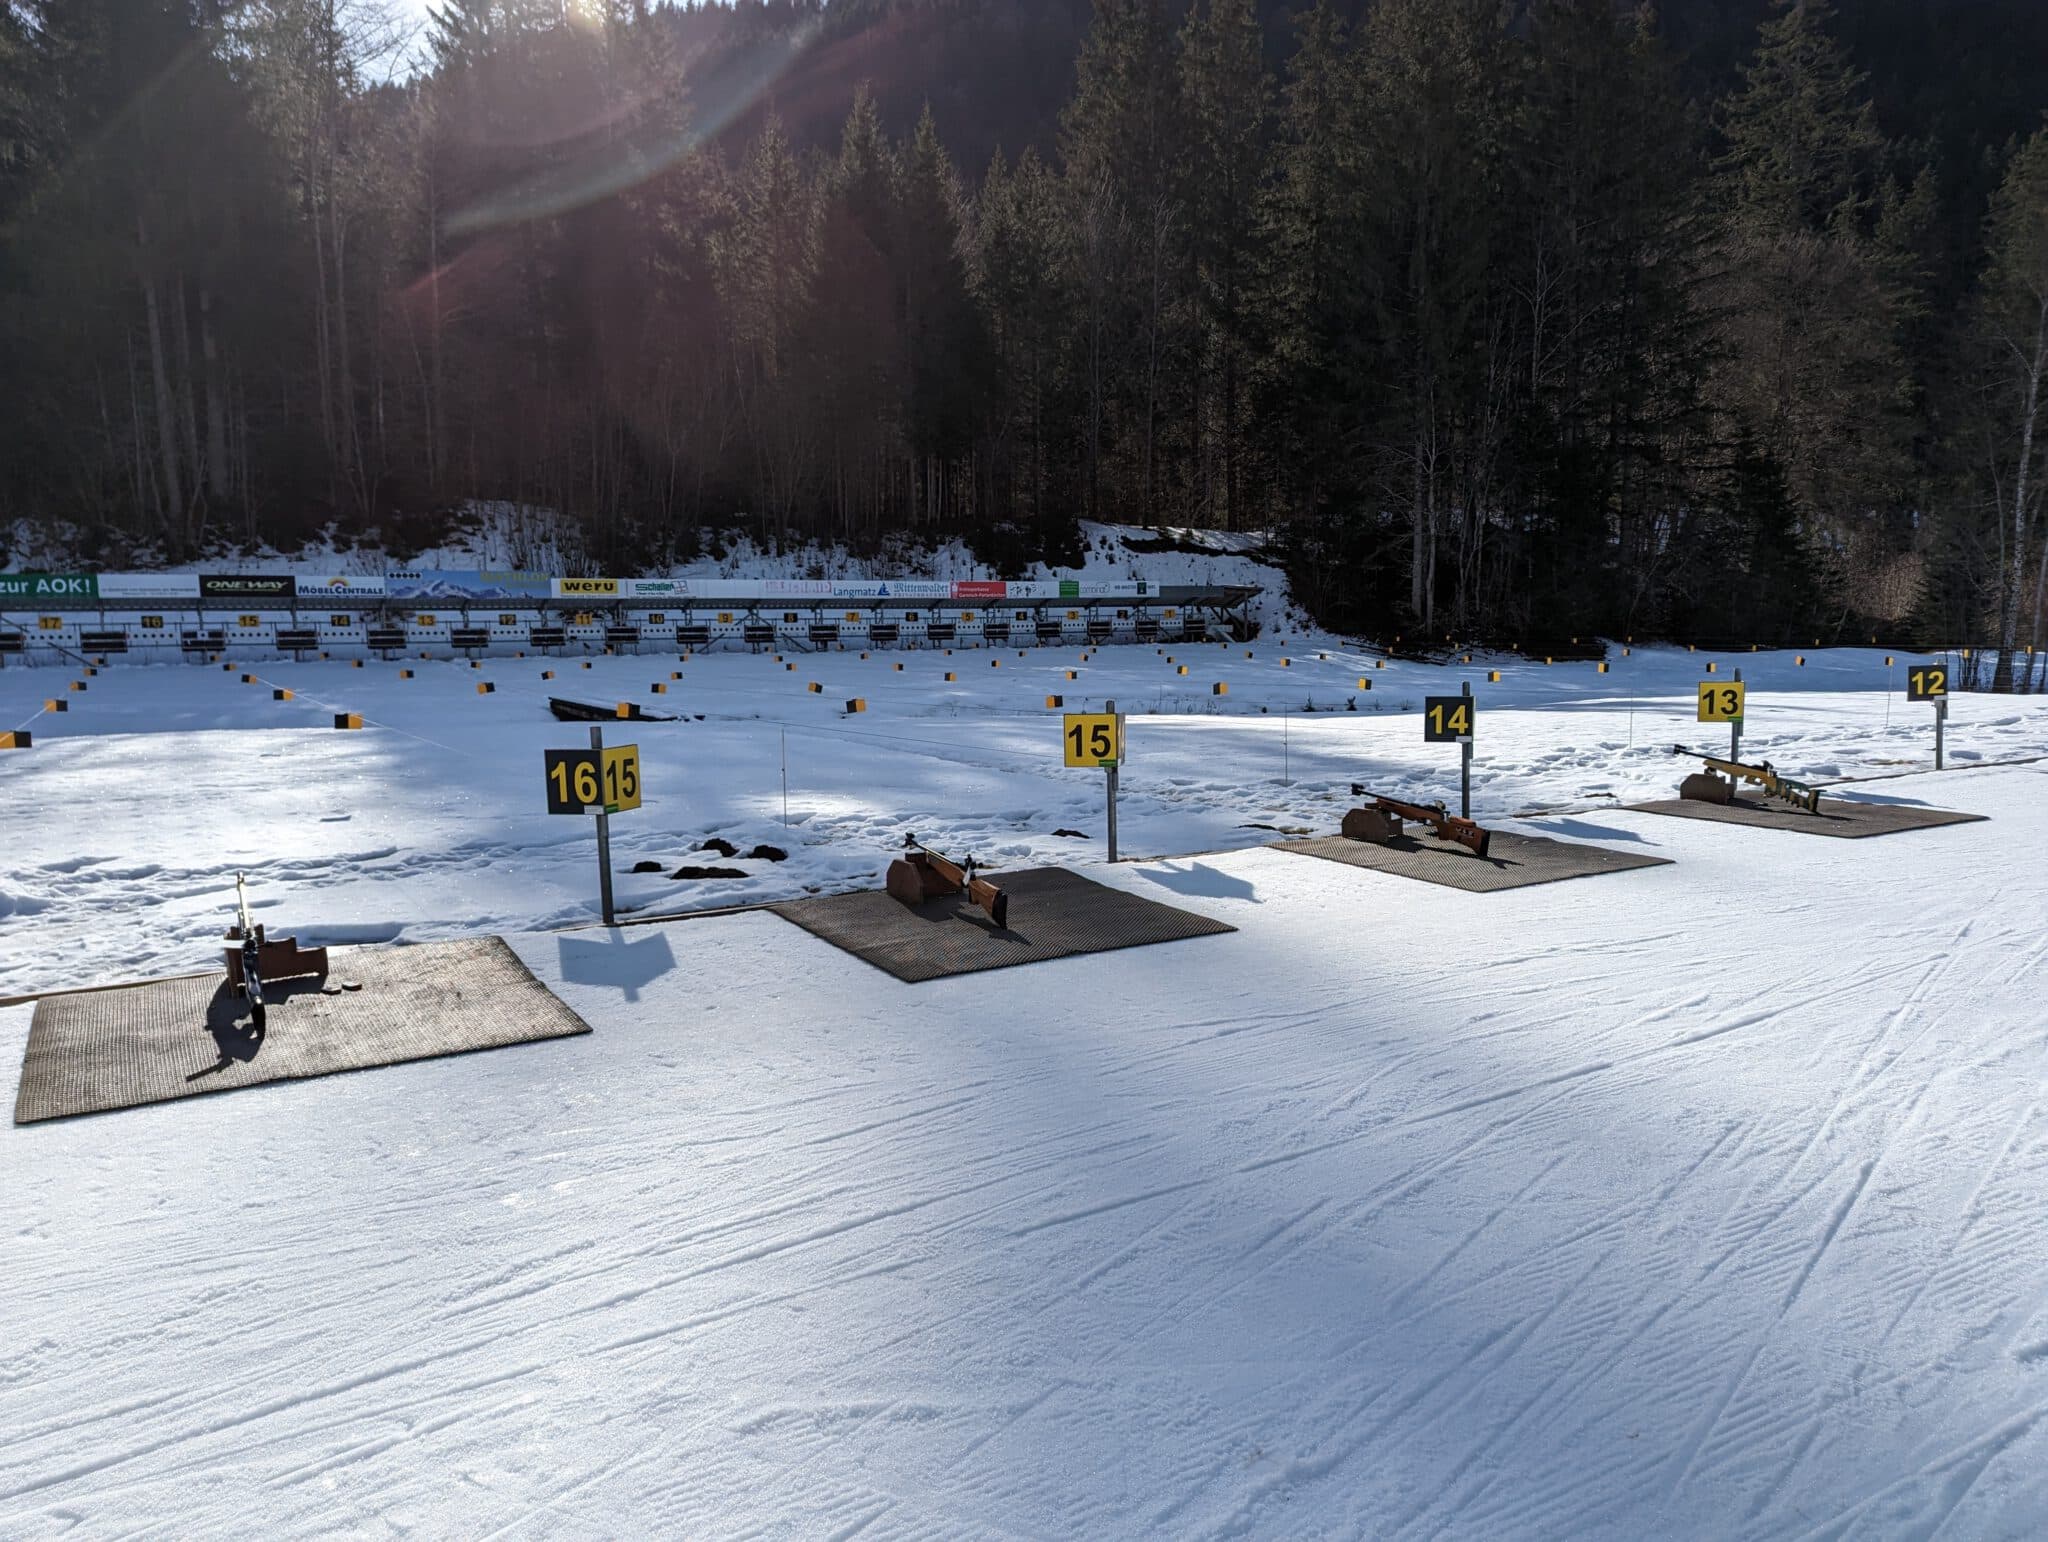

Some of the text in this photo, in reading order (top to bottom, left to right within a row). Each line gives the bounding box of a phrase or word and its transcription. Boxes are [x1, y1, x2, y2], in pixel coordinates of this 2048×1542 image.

[0, 578, 90, 593] zur AOK!
[564, 582, 614, 591] weru
[833, 586, 876, 598] Langmatz
[42, 618, 58, 629] 17
[143, 616, 161, 628] 16
[240, 616, 257, 626] 15
[332, 616, 348, 625] 14
[420, 615, 434, 625] 13
[501, 615, 515, 625] 12
[579, 615, 591, 624] 11
[650, 615, 663, 624] 10
[1911, 671, 1945, 695] 12
[1702, 689, 1738, 715] 13
[1429, 704, 1469, 734] 14
[1068, 724, 1111, 758] 15
[551, 761, 597, 804] 16
[606, 758, 637, 801] 15
